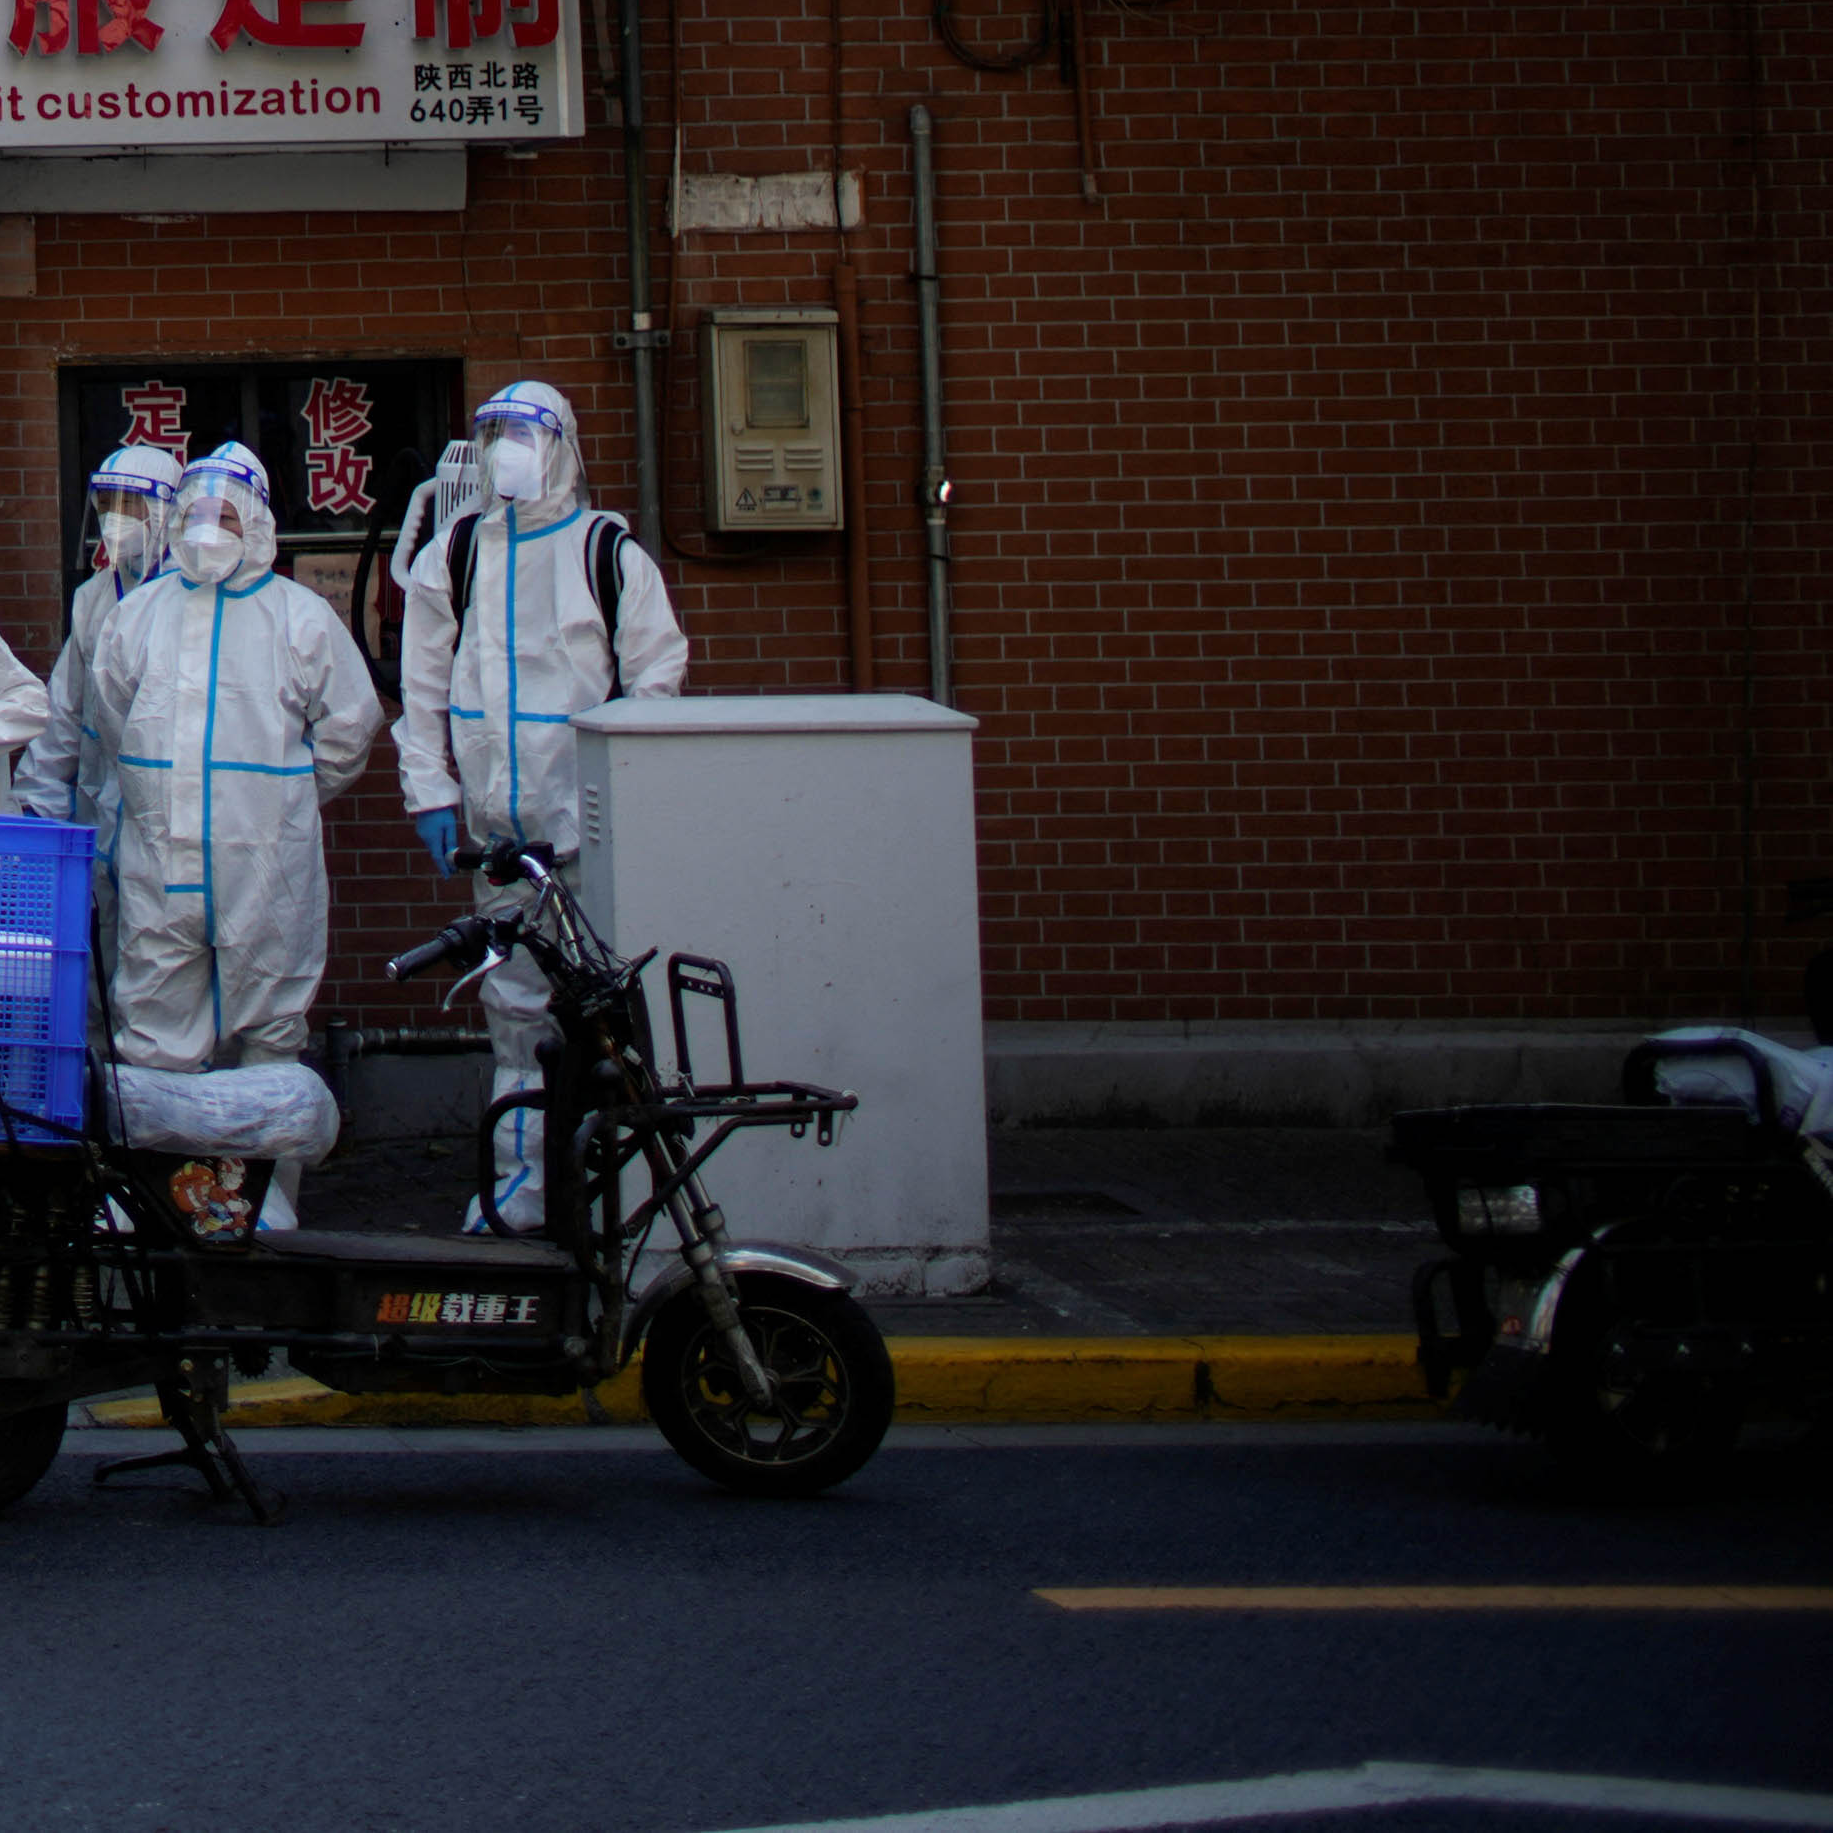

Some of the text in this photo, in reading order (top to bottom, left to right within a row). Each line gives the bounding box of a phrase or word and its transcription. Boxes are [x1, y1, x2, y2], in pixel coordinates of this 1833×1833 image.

[413, 62, 540, 92] 陕西北路
[37, 77, 382, 121] customization
[409, 95, 544, 126] 640弄1号
[301, 376, 377, 515] 修改
[375, 1292, 541, 1324] 超级载重王
